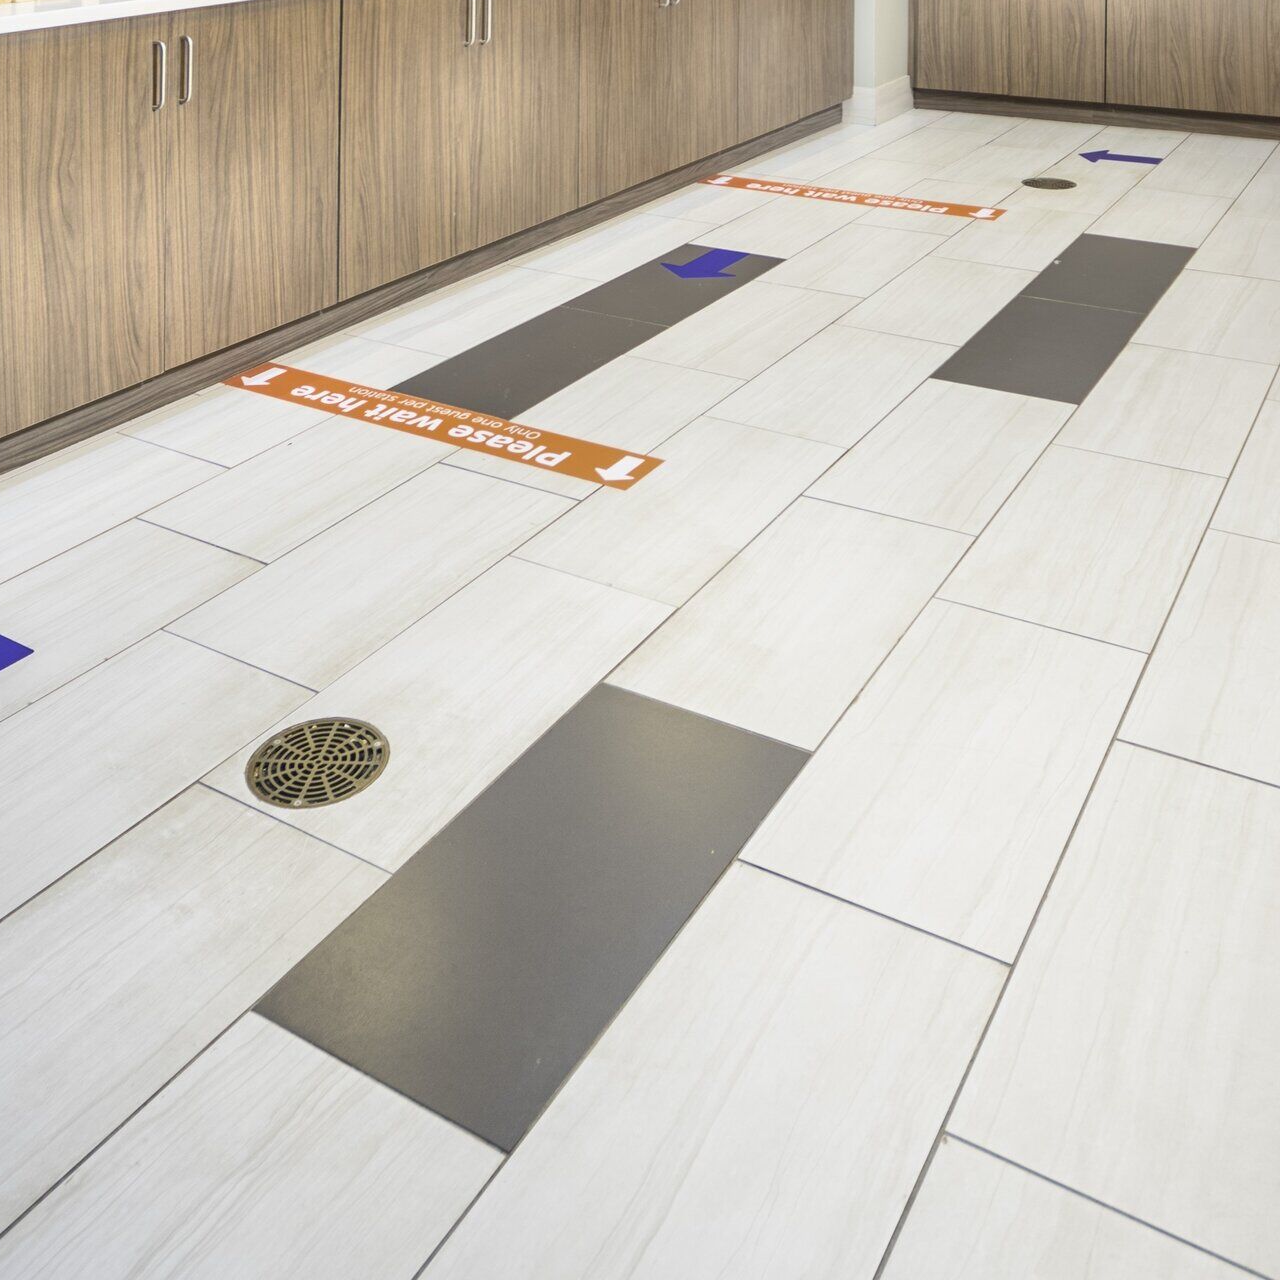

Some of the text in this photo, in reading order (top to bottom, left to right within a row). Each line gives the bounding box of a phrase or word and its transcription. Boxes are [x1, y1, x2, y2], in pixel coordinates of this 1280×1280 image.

[746, 182, 950, 215] Please wait here
[290, 384, 572, 467] Please wait here
[348, 386, 541, 440] Only one guest per station
